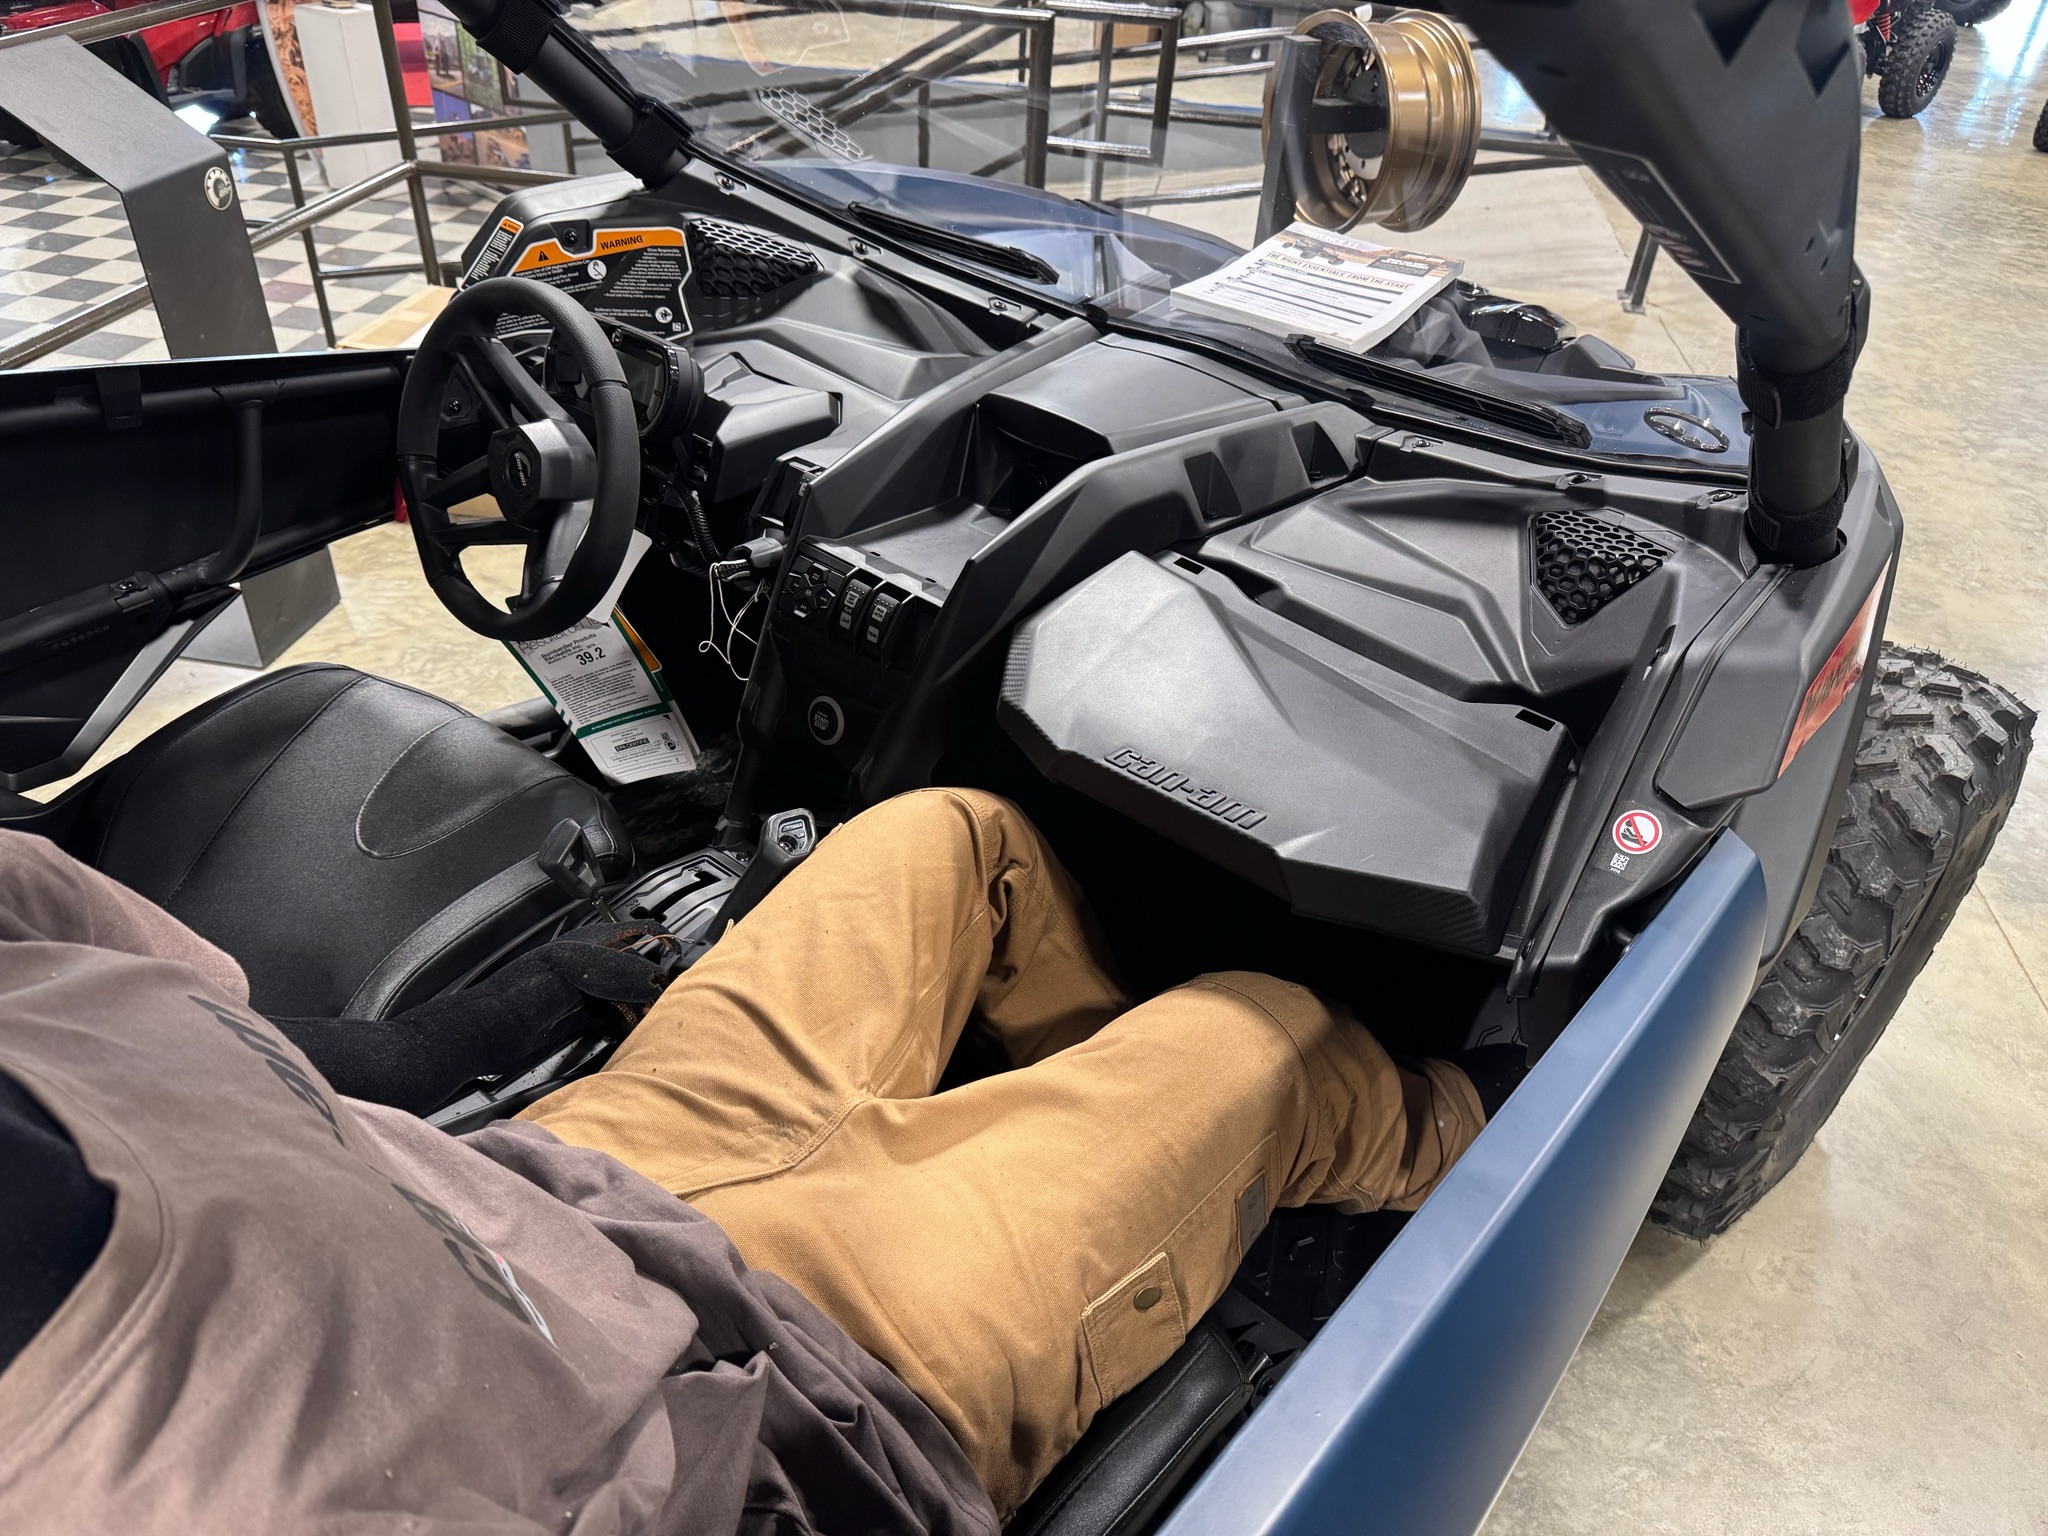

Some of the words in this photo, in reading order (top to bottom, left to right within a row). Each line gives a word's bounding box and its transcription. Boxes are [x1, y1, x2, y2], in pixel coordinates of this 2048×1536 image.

[600, 235, 643, 250] WARNING
[1282, 256, 1302, 265] RIGHT
[1347, 274, 1369, 282] FROM
[541, 643, 573, 659] Bombardier
[573, 633, 597, 645] Produits
[576, 646, 606, 666] 39.2
[814, 713, 829, 724] START
[814, 720, 827, 730] STOP
[1103, 746, 1268, 831] can-am
